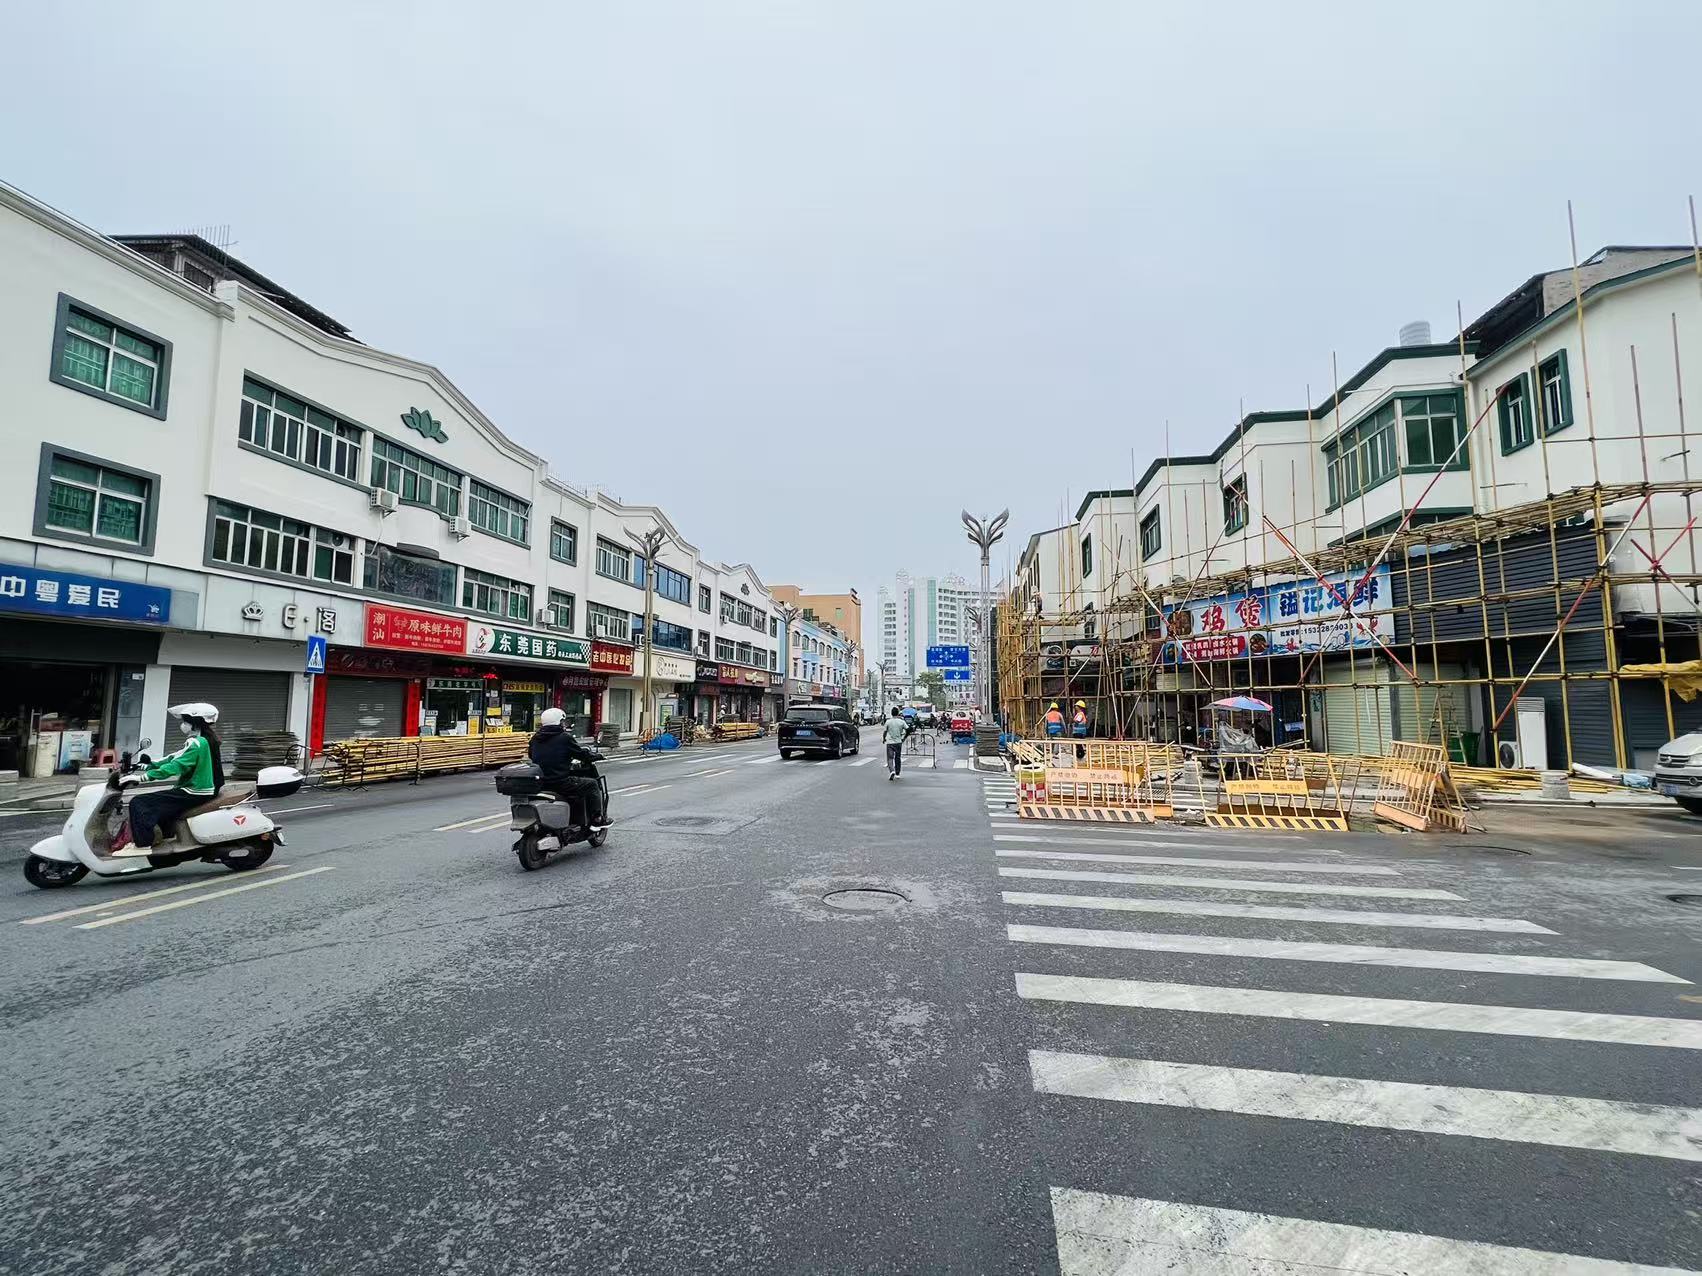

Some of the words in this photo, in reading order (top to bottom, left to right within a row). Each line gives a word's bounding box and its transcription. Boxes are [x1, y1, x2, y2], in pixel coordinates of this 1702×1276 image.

[1, 575, 120, 609] 中粤爱民
[408, 619, 462, 638] 原味鲜牛肉
[499, 633, 557, 657] 东莞国药
